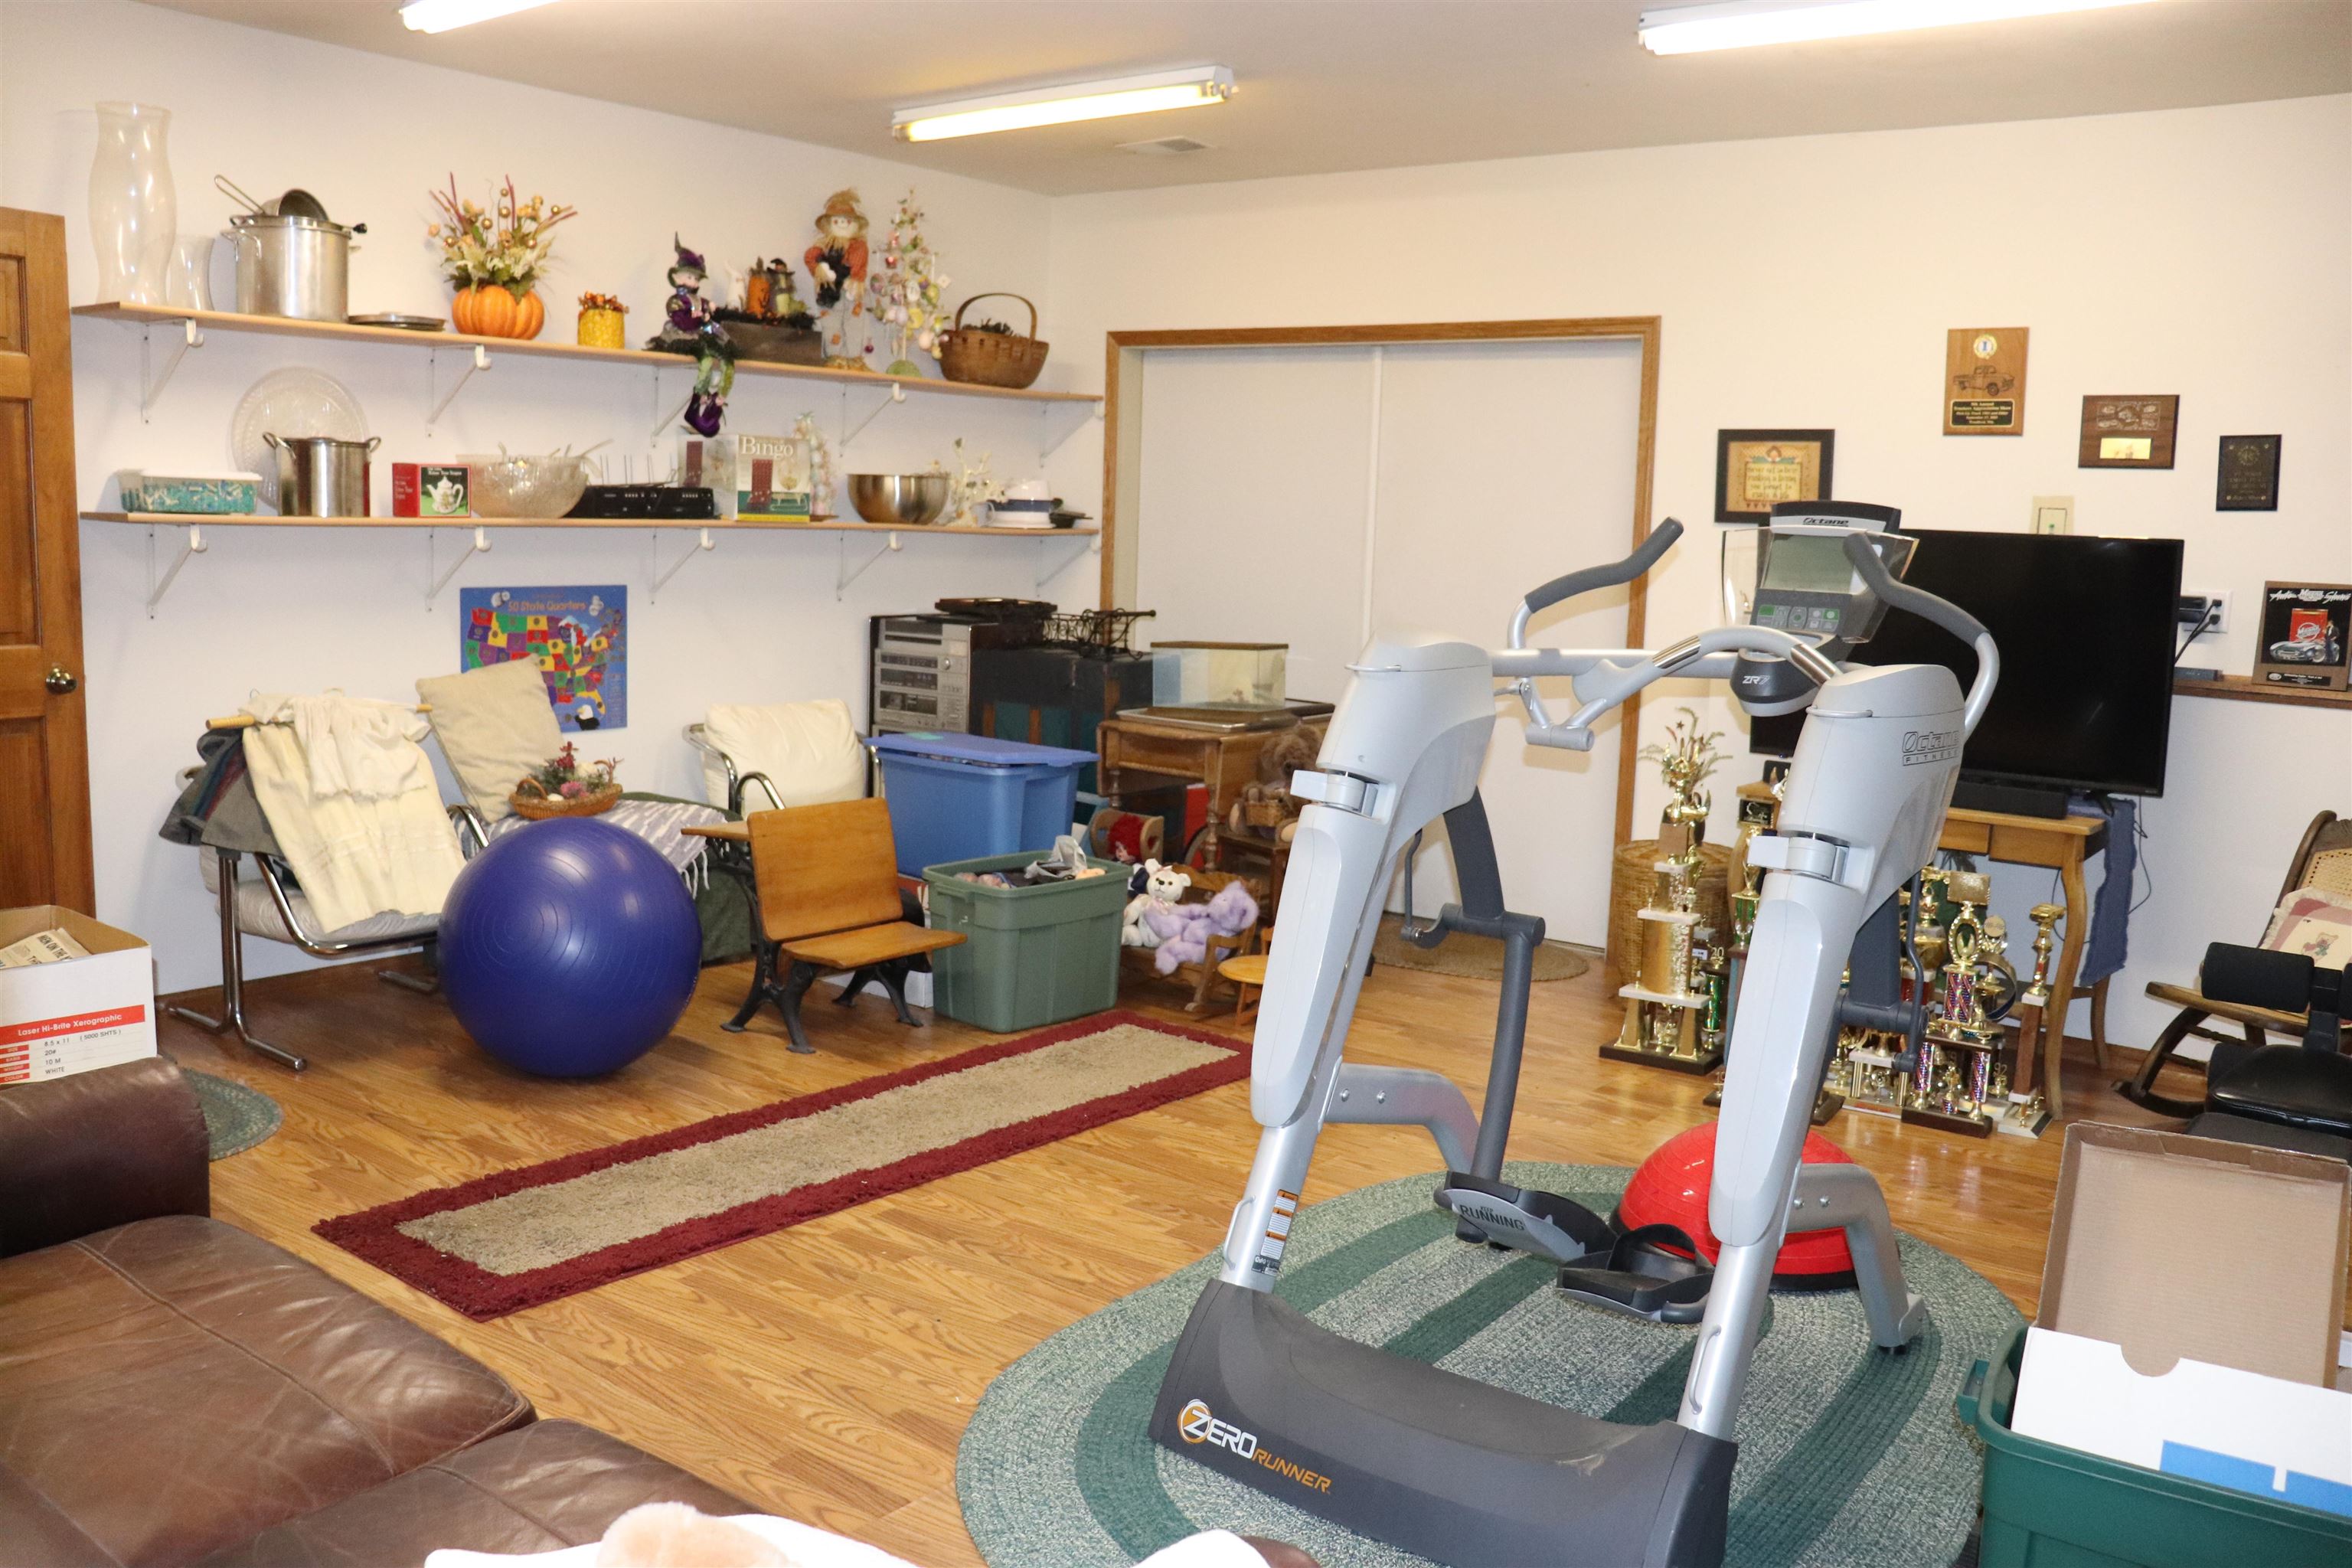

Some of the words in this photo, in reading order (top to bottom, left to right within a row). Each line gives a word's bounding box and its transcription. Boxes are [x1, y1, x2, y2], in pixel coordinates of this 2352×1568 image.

[741, 436, 794, 459] Bingo
[508, 601, 519, 612] 50
[521, 601, 546, 611] State
[546, 600, 586, 611] Quarters
[1742, 675, 1771, 685] ZR7
[1903, 730, 1960, 753] Octane
[1906, 750, 1958, 763] FITNESS
[37, 934, 53, 946] MEN
[46, 942, 60, 952] ON
[53, 948, 68, 959] THE
[18, 1027, 41, 1037] Laser
[41, 1023, 71, 1033] Hi-Brite
[73, 1014, 122, 1027] Xerographic
[1459, 1204, 1525, 1231] RUNNING
[1184, 1409, 1258, 1459] ZERO
[1251, 1448, 1333, 1493] RUNNER
